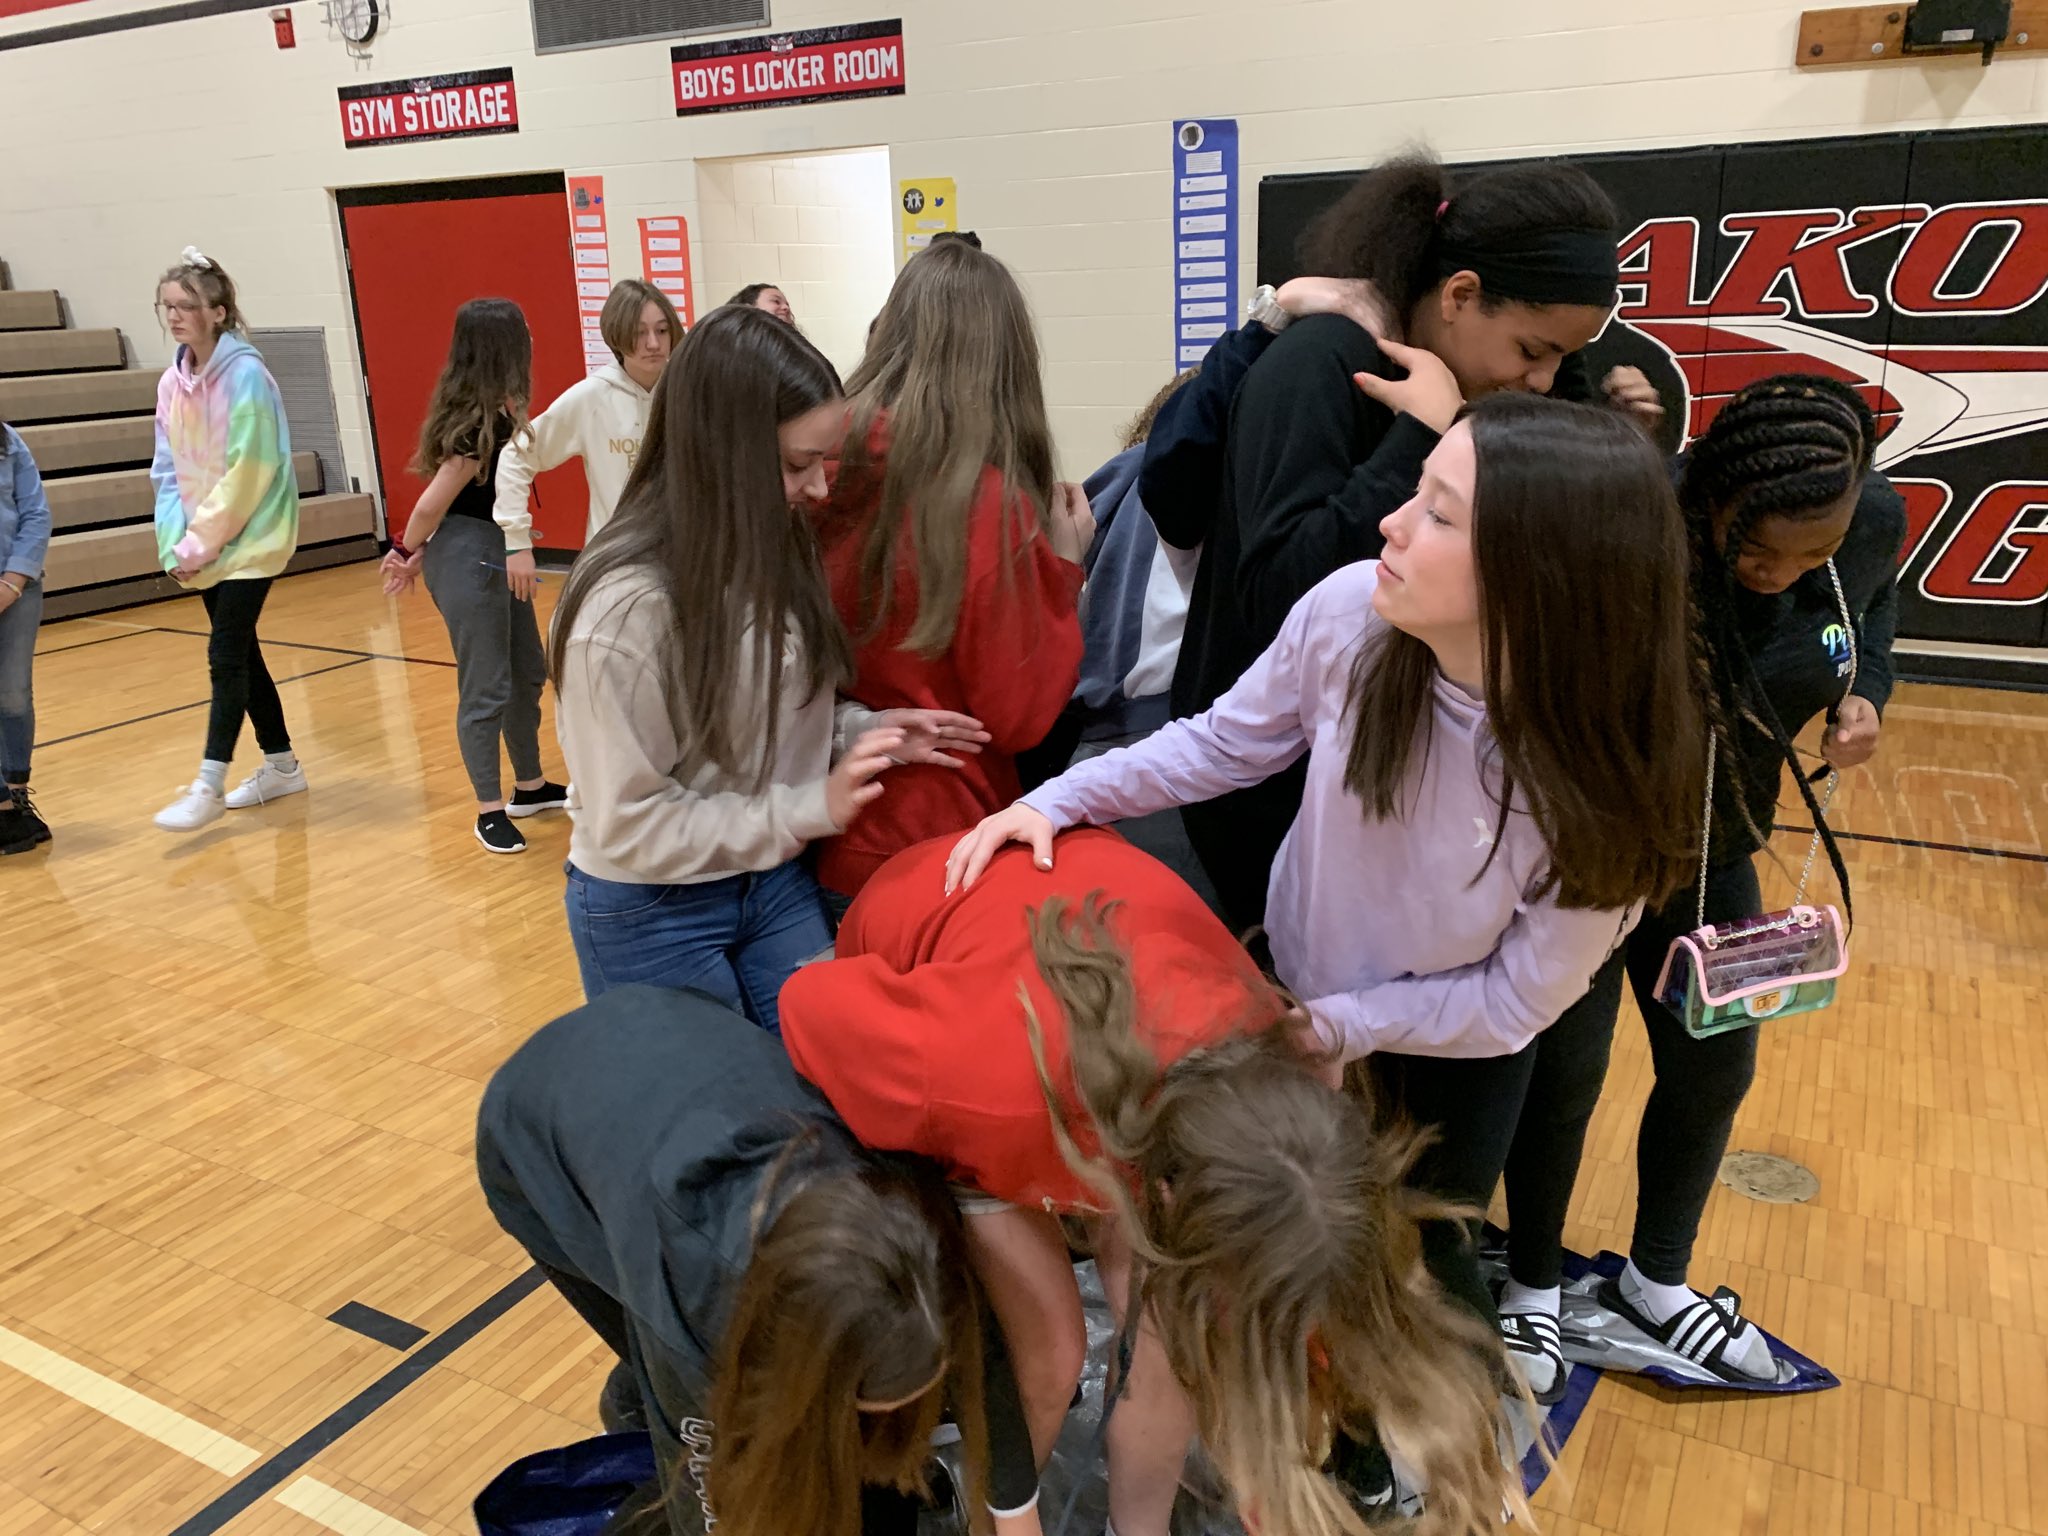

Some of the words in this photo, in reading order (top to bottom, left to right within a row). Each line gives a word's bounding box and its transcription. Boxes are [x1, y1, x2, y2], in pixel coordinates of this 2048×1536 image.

[680, 65, 735, 101] BOYS
[742, 55, 826, 94] LOCKER
[833, 46, 899, 84] ROOM
[347, 98, 397, 138] GYM
[402, 84, 511, 132] STORAGE
[1588, 198, 2048, 342] AKO
